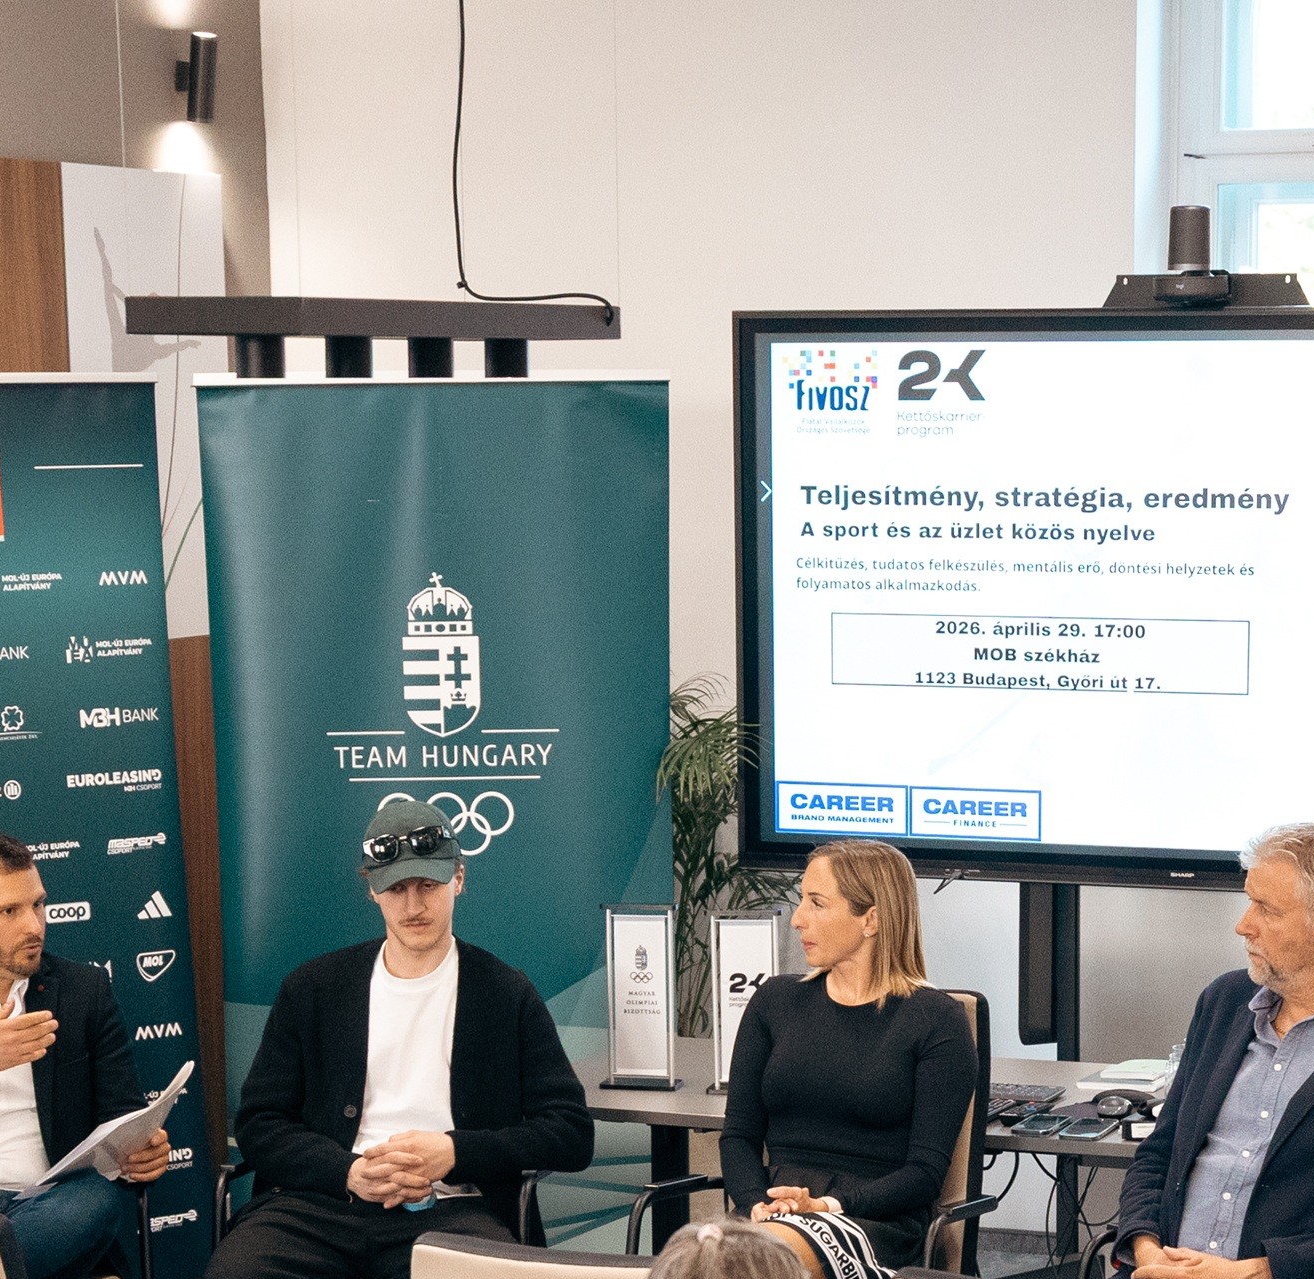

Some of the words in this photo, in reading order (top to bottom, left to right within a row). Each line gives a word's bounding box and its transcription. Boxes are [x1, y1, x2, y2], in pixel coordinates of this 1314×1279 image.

[897, 425, 954, 437] program
[800, 485, 985, 512] Teljesítmény,
[995, 487, 1132, 513] stratégia,
[1143, 488, 1290, 515] eredmény
[801, 522, 815, 537] A
[823, 522, 879, 541] sport
[887, 522, 911, 538] és
[919, 526, 943, 539] az
[950, 523, 1004, 539] üzlet
[1012, 523, 1075, 540] közös
[1083, 525, 1155, 545] nyelve
[873, 558, 925, 571] tudatos
[929, 559, 1008, 573] felkészülés,
[1013, 560, 1073, 573] mentális
[1078, 561, 1104, 575] erő,
[1109, 562, 1161, 575] döntési
[1167, 563, 1235, 578] helyzetek
[1239, 564, 1255, 576] és
[31, 572, 62, 581] EURÓPA
[99, 570, 148, 586] MVM
[796, 578, 871, 592] folyamatos
[875, 578, 981, 592] alkalmazkodás.
[935, 621, 986, 635] 2026.
[992, 621, 1051, 639] április
[1058, 623, 1086, 638] 29.
[1094, 624, 1146, 638] 17:00
[974, 648, 1017, 661] MOB
[1023, 648, 1100, 663] székház
[915, 671, 956, 685] 1123
[962, 673, 1051, 690] Budapest,
[1057, 674, 1103, 691] Győri
[1110, 676, 1128, 689] út
[1134, 677, 1161, 690] 17.
[79, 707, 120, 728] MBH
[122, 708, 159, 723] BANK
[334, 746, 407, 769] TEAM
[422, 743, 553, 768] HUNGARY
[790, 793, 894, 812] CAREER
[923, 798, 1027, 817] CAREER
[791, 814, 825, 822] BRAND
[827, 815, 894, 824] MANAGEMENT
[953, 819, 997, 828] FINANCE
[25, 842, 48, 851] OL-ÚJ
[32, 851, 69, 860] APÍTVÁNY
[49, 906, 86, 919] coop
[143, 955, 164, 968] MOL
[135, 1022, 183, 1041] MVM
